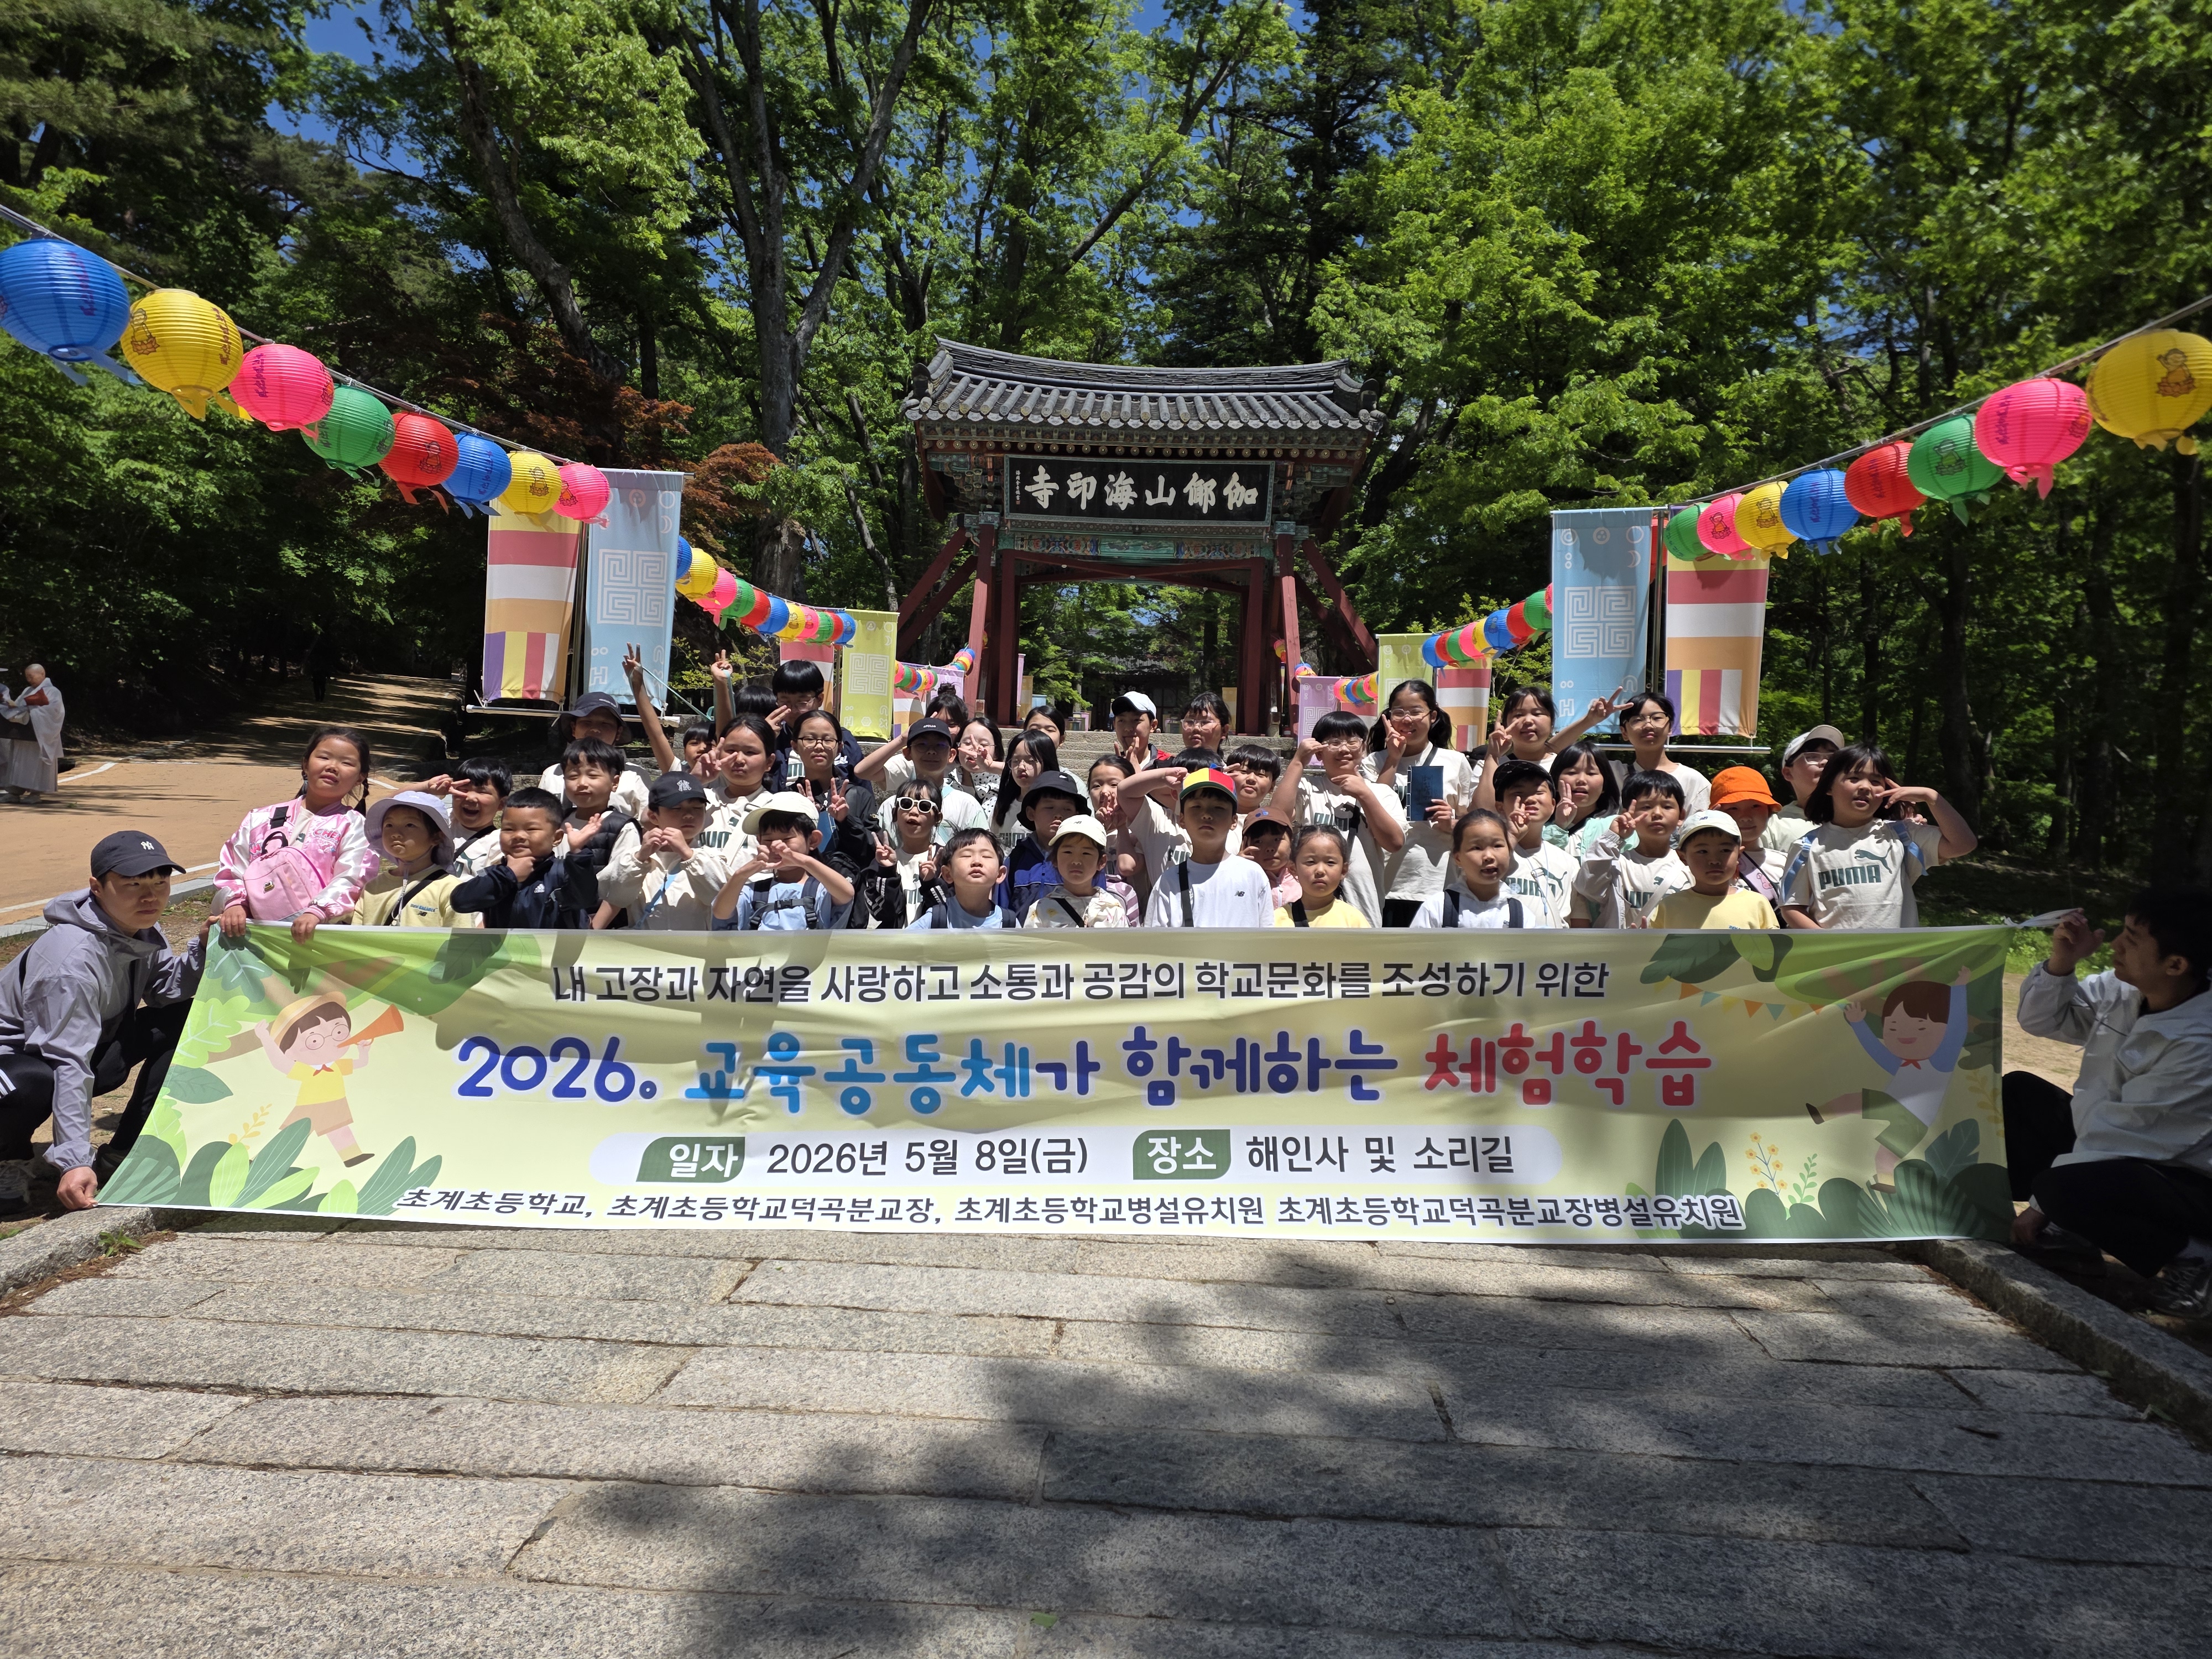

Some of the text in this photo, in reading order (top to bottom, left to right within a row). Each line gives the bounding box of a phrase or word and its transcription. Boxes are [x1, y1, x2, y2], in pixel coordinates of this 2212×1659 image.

[676, 780, 692, 791] NY
[140, 841, 154, 850] NY
[1818, 864, 1881, 890] PUMA
[554, 962, 1609, 1003] 내 고장과 자연을 사랑하고 소통과 공감의 학교문화를 조성하기 위한
[685, 1032, 1100, 1115] 교육공동체가
[1123, 1026, 1398, 1106] 함께하는
[1425, 1021, 1712, 1106] 체험학습
[669, 1136, 1514, 1178] 일자 2026년 5월 8일(금) 장소 해인사 및 소리길
[397, 1190, 1744, 1228] 초계초등학교, 초계초등학교덕곡분교장, 초계초등학교병설유치원 초계초등학교덕곡분교장병설유치원
